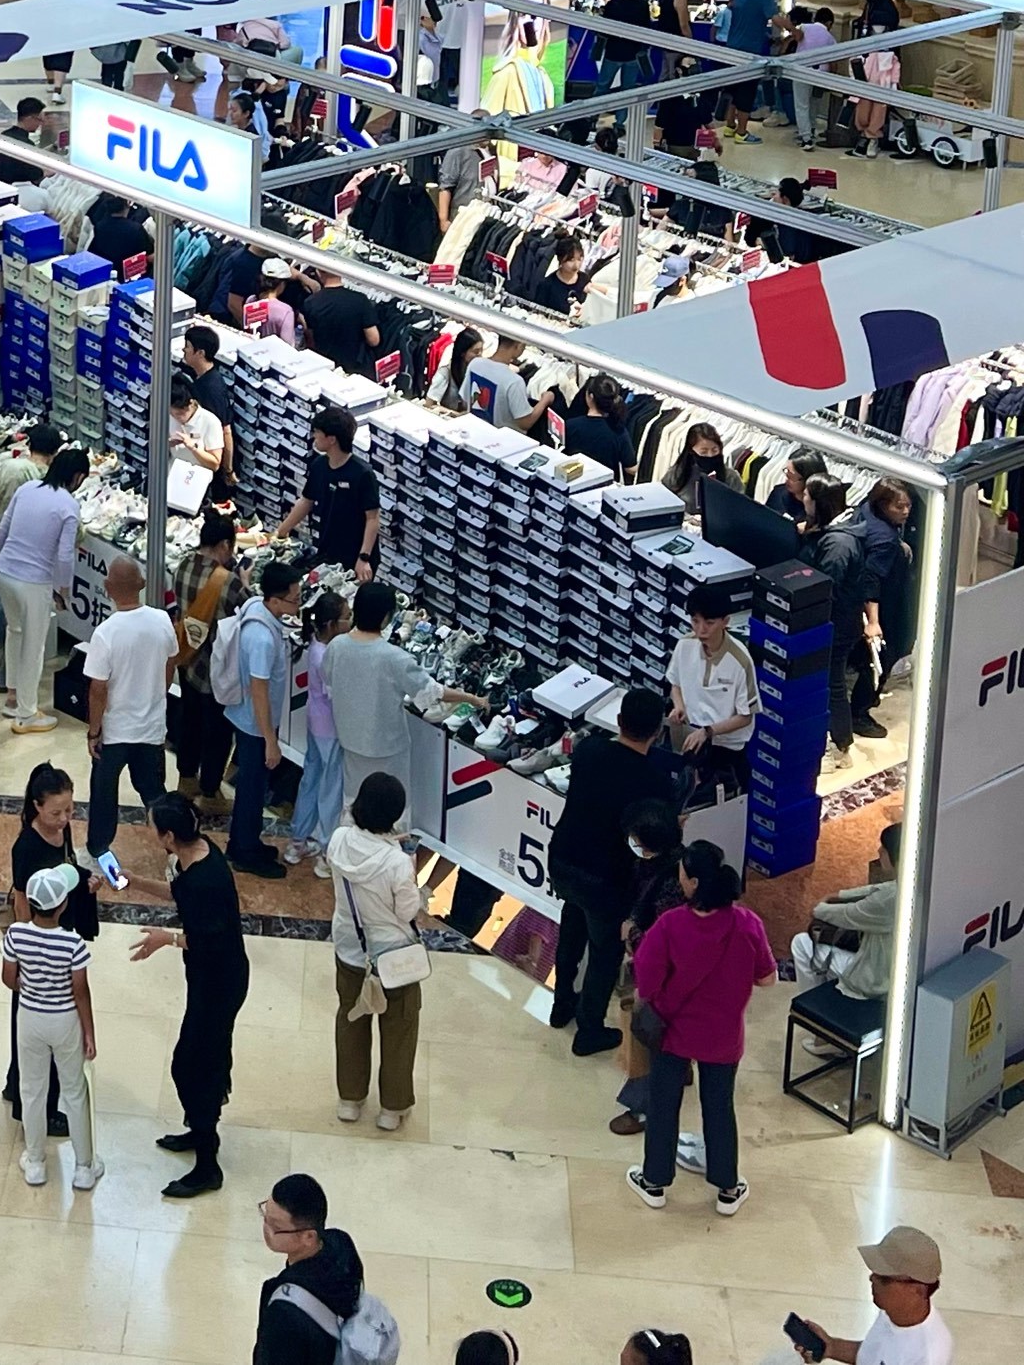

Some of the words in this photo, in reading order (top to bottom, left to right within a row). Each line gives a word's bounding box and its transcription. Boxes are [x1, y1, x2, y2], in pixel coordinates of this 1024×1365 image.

[107, 114, 208, 191] FILA
[78, 547, 108, 577] FILA
[527, 800, 556, 830] FIL
